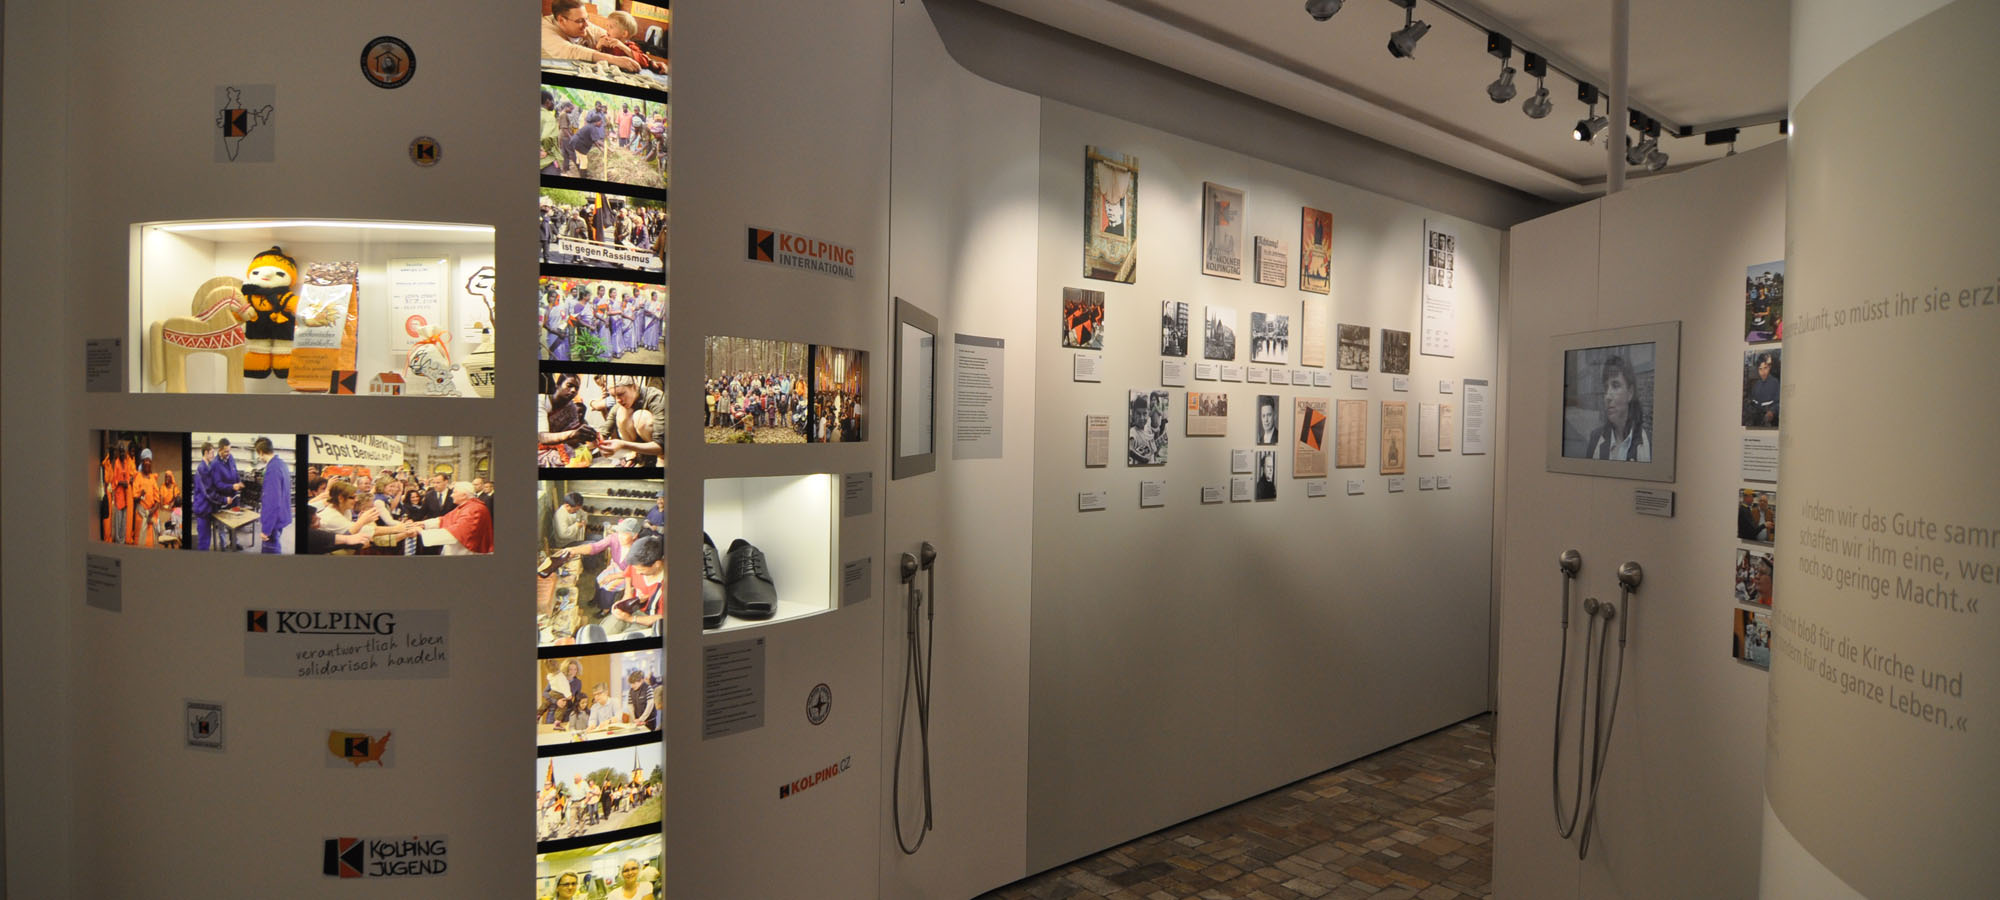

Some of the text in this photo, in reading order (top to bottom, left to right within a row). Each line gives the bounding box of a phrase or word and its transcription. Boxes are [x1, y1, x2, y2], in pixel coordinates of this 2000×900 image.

[562, 242, 650, 264] ist gegen Rassismus
[780, 233, 854, 266] KOLPING
[780, 253, 854, 278] INTERNATIONAL
[1834, 308, 1846, 327] so
[1850, 297, 1889, 324] müsst
[1895, 292, 1919, 317] ihr
[1924, 287, 1950, 313] sie
[312, 436, 351, 461] Papst
[1838, 505, 1858, 529] wir
[1862, 507, 1887, 534] das
[1892, 512, 1937, 541] Gute
[1799, 526, 1838, 553] schaffen
[1842, 536, 1863, 559] wir
[1867, 538, 1897, 567] ihm
[1903, 546, 1950, 581] eine,
[1799, 555, 1979, 614] noch so geringe Macht.«
[276, 610, 396, 635] KOLPING
[296, 633, 444, 660] verantwortlich leben
[1797, 618, 1817, 645] bloß
[1819, 626, 1835, 653] für
[1838, 636, 1857, 663] die
[1862, 645, 1914, 683] Kirche
[1922, 669, 1963, 698] und
[298, 649, 446, 678] solidarisch handeln
[1803, 648, 1817, 673] für
[1819, 657, 1837, 684] das
[1840, 672, 1884, 704] ganze
[1889, 685, 1968, 733] Leben.«
[791, 756, 851, 795] KOLPING.CZ
[369, 836, 447, 859] KOLPING
[369, 860, 447, 878] JUGEND
